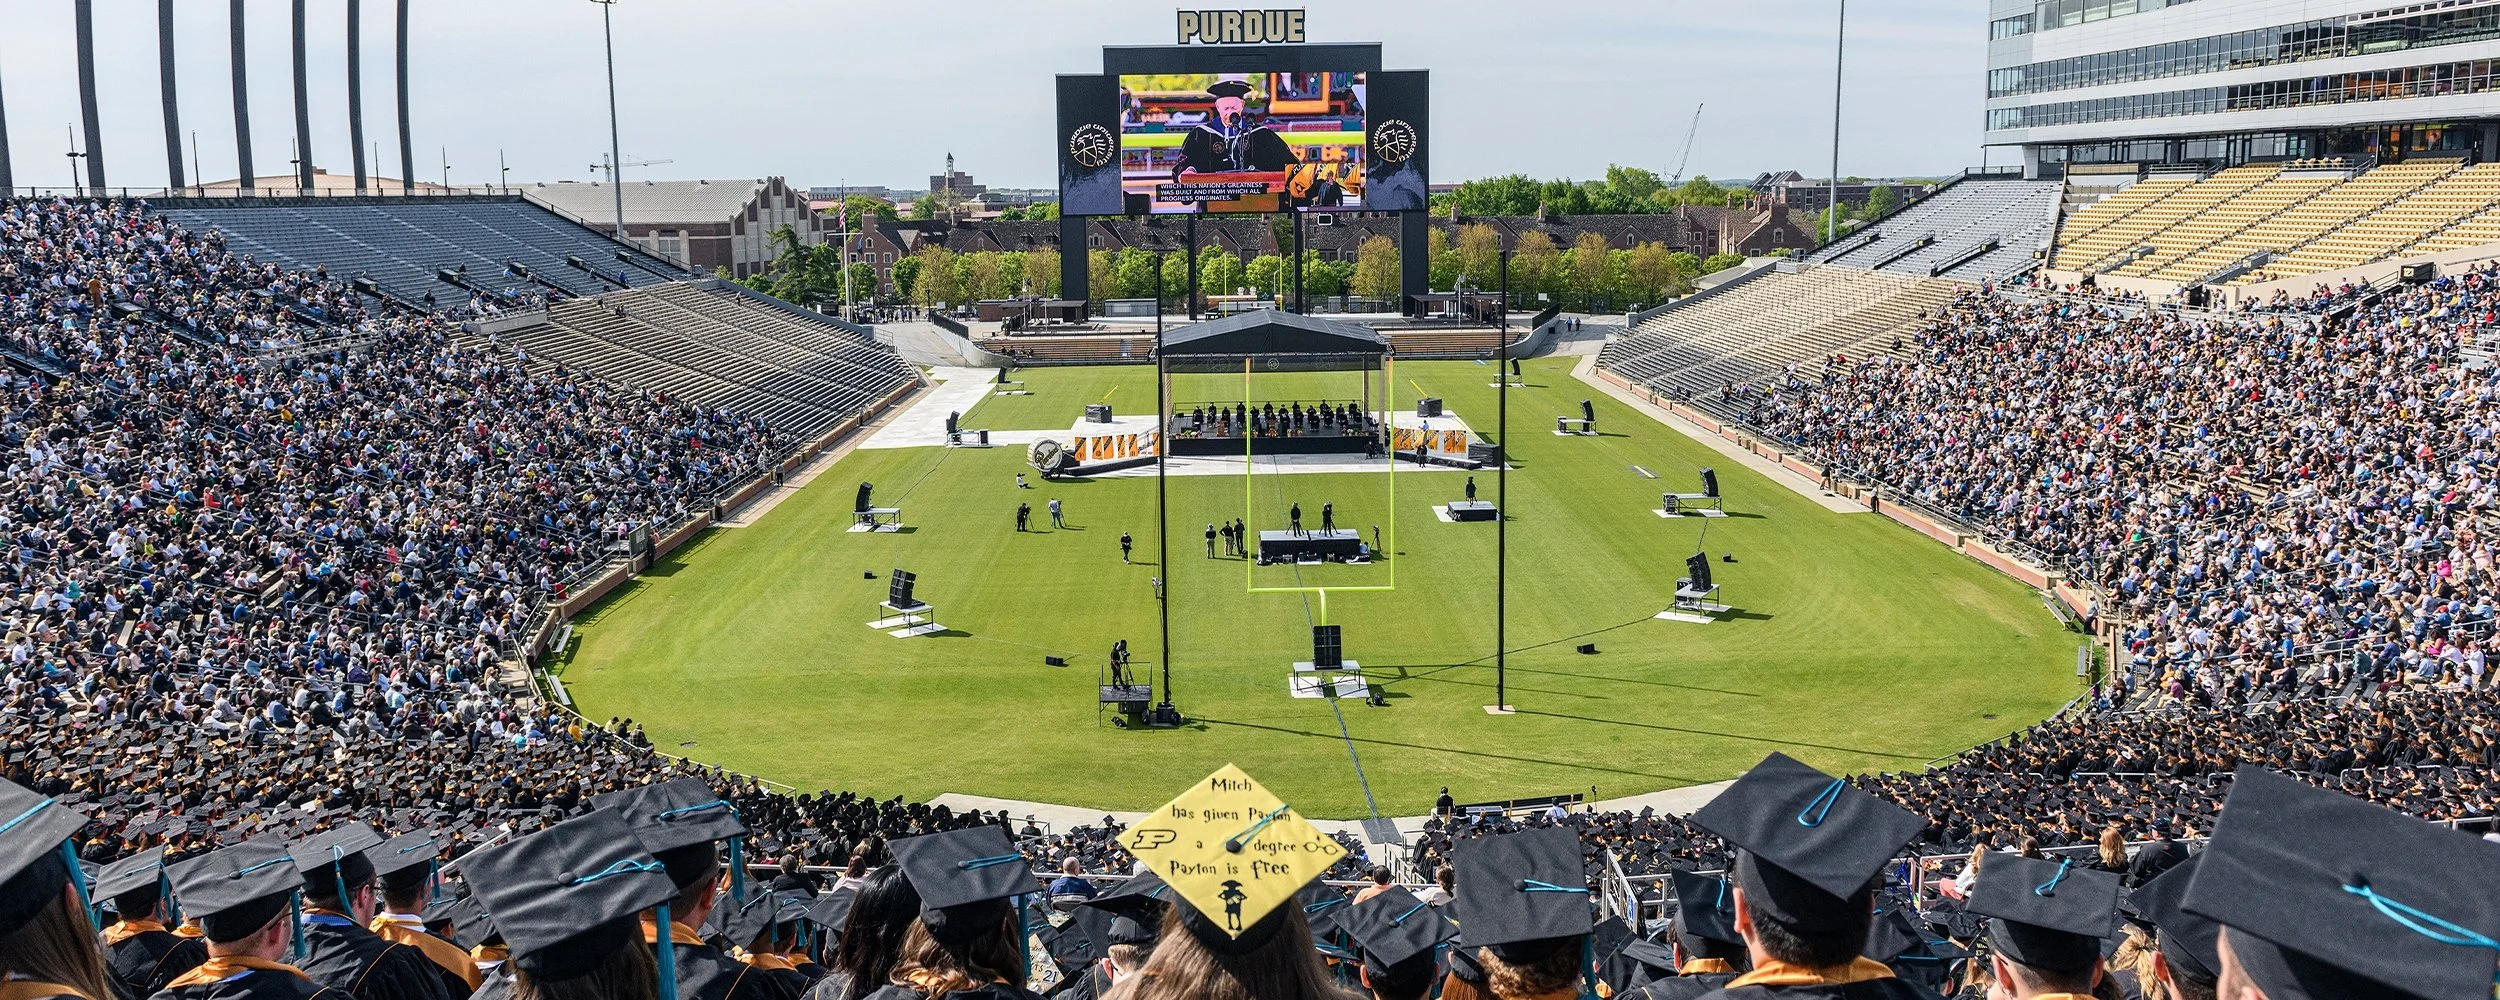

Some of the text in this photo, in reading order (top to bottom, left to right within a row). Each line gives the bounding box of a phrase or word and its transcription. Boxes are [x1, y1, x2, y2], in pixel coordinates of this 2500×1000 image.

[1177, 10, 1305, 44] PURDUE
[1211, 778, 1252, 793] Mitch
[1172, 804, 1195, 819] has
[1203, 808, 1239, 823] given
[1131, 829, 1177, 849] P
[1196, 840, 1297, 856] a degree
[1170, 860, 1217, 877] Payton
[1226, 862, 1239, 875] is
[1042, 969, 1058, 984] 21
